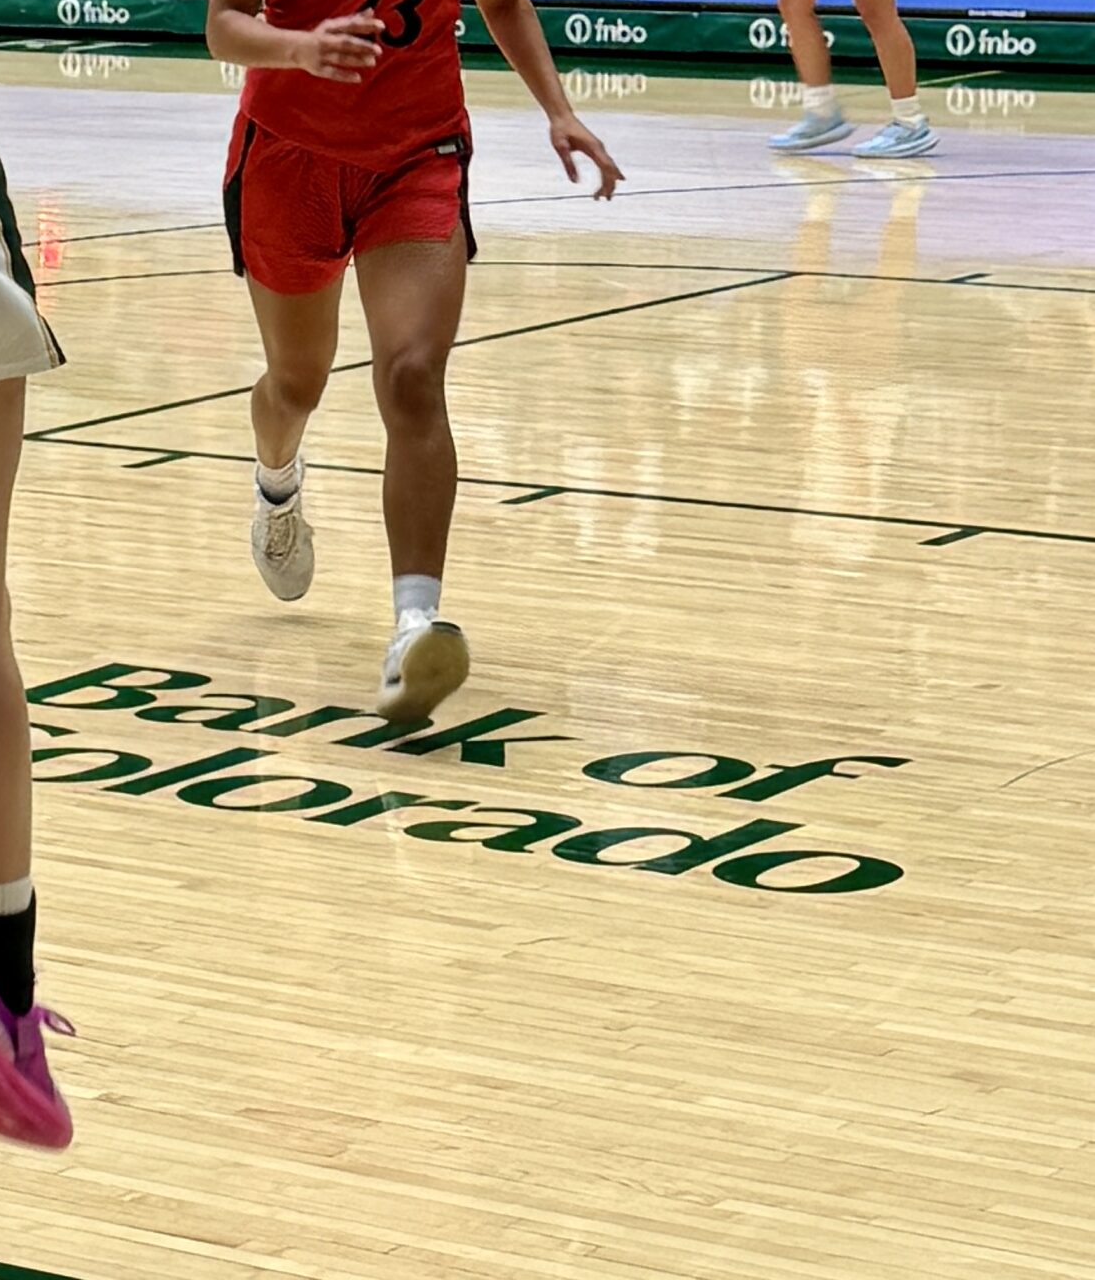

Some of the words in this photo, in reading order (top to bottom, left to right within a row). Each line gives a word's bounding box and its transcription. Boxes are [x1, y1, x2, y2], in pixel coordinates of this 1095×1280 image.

[82, 0, 130, 24] fnbo
[594, 17, 647, 43] fnbo
[978, 28, 1037, 56] fnbo
[26, 662, 583, 768] Bank
[582, 751, 913, 803] of
